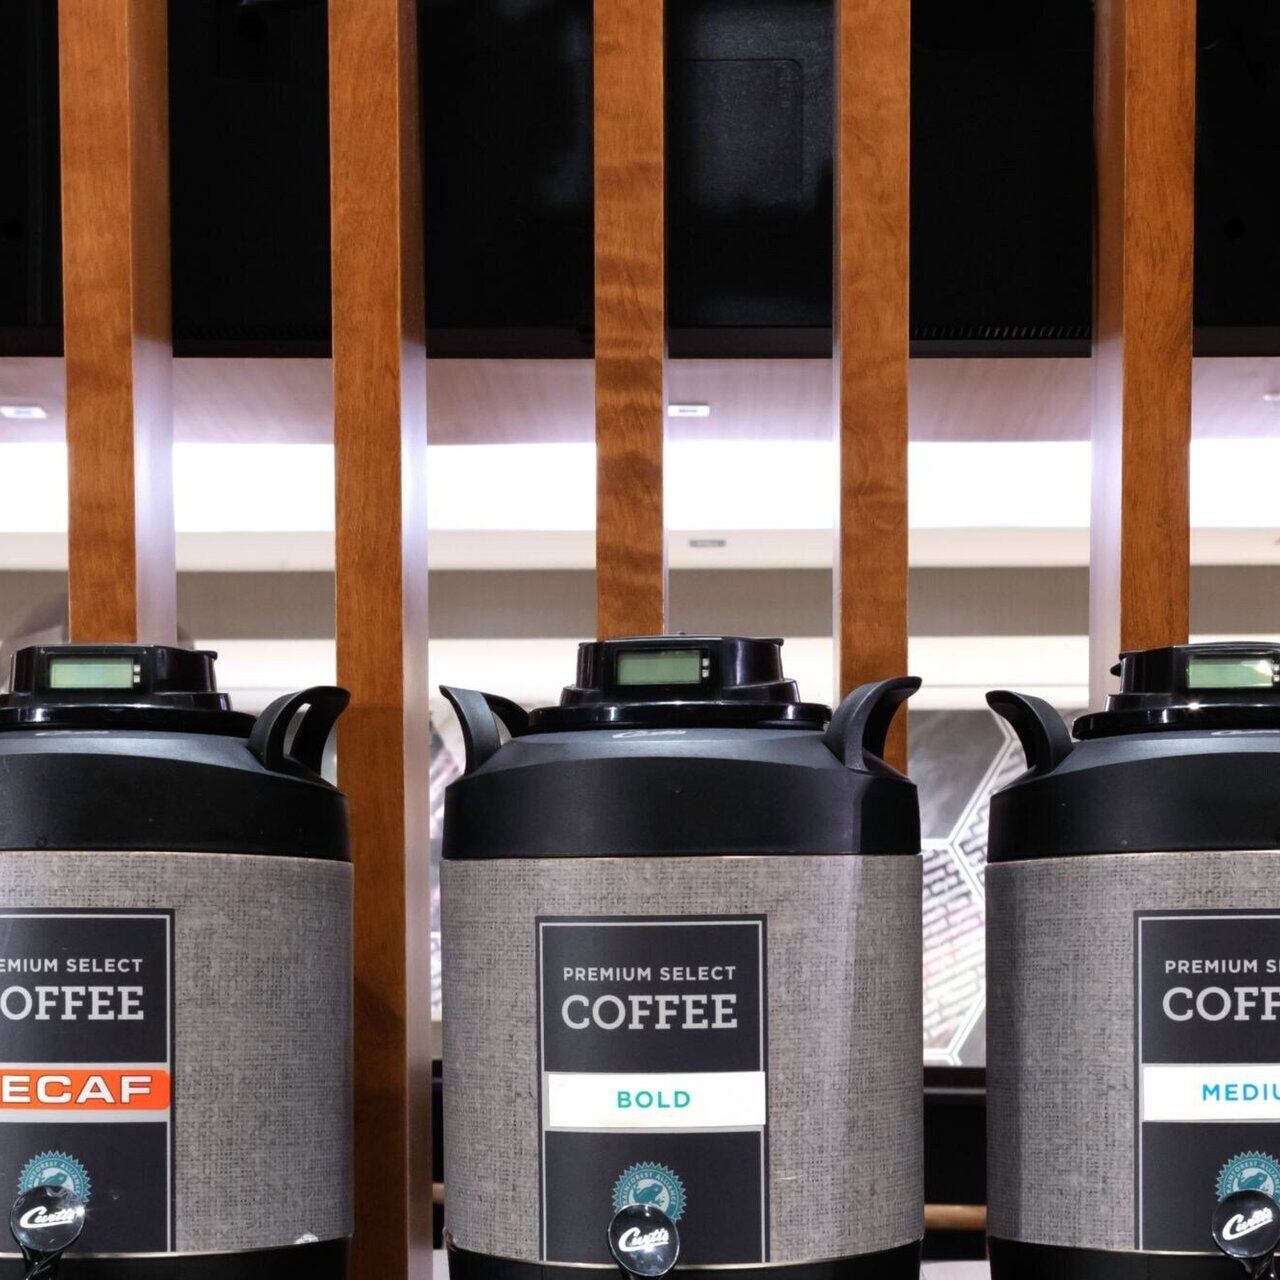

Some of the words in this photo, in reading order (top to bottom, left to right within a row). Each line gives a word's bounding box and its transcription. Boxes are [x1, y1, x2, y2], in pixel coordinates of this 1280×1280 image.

[66, 959, 143, 973] SELECT
[563, 967, 651, 981] PREMIUM
[660, 966, 736, 981] SELECT
[1165, 960, 1258, 974] PREMIUM
[562, 994, 738, 1030] COFFEE
[617, 1091, 691, 1108] BOLD
[28, 1161, 58, 1188] AINFOREST
[656, 1173, 677, 1205] ALLIANCE
